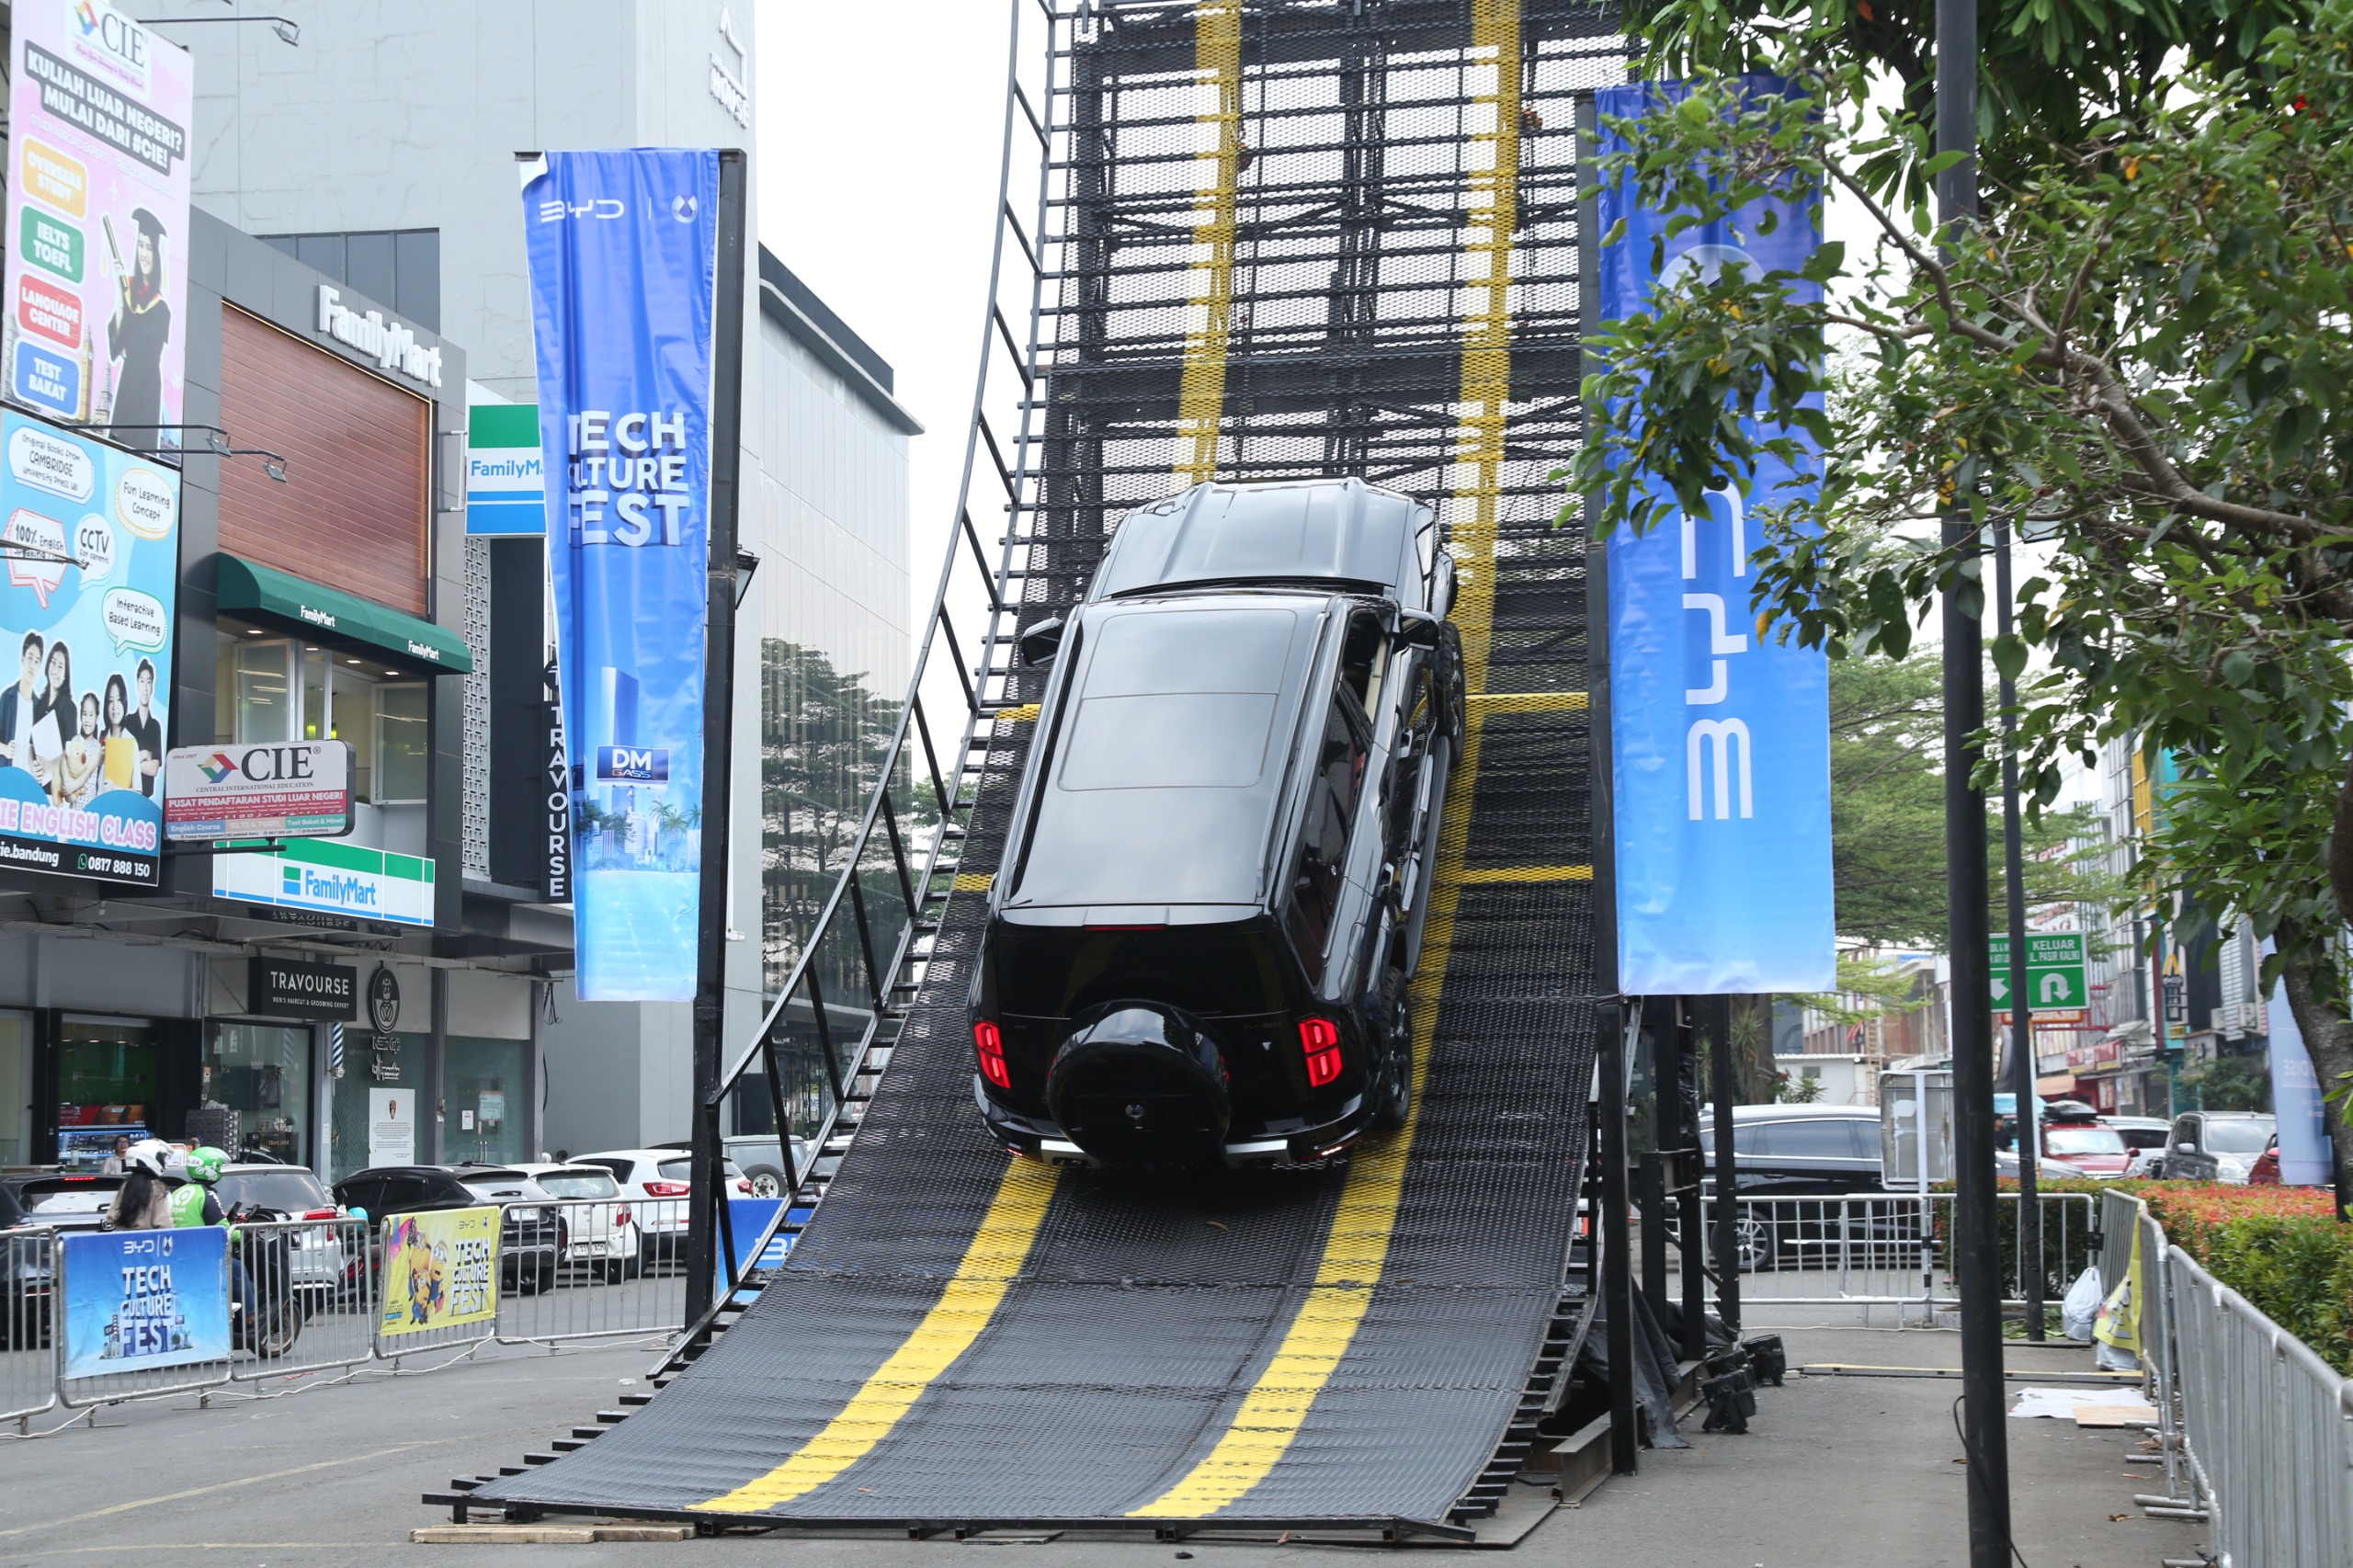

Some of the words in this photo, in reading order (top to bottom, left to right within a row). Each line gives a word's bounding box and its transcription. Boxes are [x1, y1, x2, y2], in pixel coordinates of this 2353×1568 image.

[101, 13, 144, 68] CIE
[28, 49, 86, 98] KULIAH
[86, 82, 124, 120] LUAR
[127, 105, 182, 151] NEGERI?
[44, 84, 93, 128] MULAI
[96, 112, 130, 148] DARI
[133, 132, 168, 169] #CIE!
[28, 151, 82, 191] OVERSEAS
[37, 173, 74, 201] STUDY
[540, 199, 625, 223] BYD
[37, 221, 71, 251] IELTS
[33, 238, 73, 273] TOEFL
[22, 286, 80, 324] LANGUAGE
[29, 307, 71, 336] CENTER
[319, 285, 442, 388] FamilyMart
[33, 357, 63, 381] TEST
[28, 373, 67, 402] BAKAT
[47, 442, 64, 456] Books
[29, 449, 74, 477] CAMBRIDGE
[123, 482, 137, 495] Fun
[139, 485, 170, 508] Learning
[131, 502, 161, 521] Concept
[16, 523, 38, 544] 100%
[40, 535, 64, 551] English
[80, 528, 109, 553] CCTV
[117, 598, 154, 618] Interactive
[301, 605, 335, 627] FamilyMart
[108, 612, 129, 627] Based
[131, 617, 161, 636] Learning
[408, 641, 439, 660] FamilyMart
[241, 746, 314, 782] CIE
[612, 749, 653, 771] DM
[278, 781, 314, 790] EDUCATION
[611, 769, 652, 778] GASS
[168, 799, 198, 808] PUSAT
[198, 795, 260, 807] PENDAFTARAN
[261, 793, 287, 803] STUDI
[288, 792, 311, 802] LUAR
[312, 791, 344, 801] NEGERI
[548, 706, 568, 897] TRAVOURSE
[21, 803, 98, 842] ENGLISH
[101, 814, 156, 850] CLASS
[171, 824, 196, 833] English
[0, 841, 59, 867] ie.bandung
[88, 856, 111, 873] 0817
[113, 859, 131, 875] 888
[134, 862, 150, 878] 150
[306, 869, 376, 905] FamilyMart
[2032, 939, 2075, 950] KELUAR
[2040, 951, 2058, 961] PASIR
[271, 971, 349, 994] TRAVOURSE
[459, 1221, 476, 1230] BYD
[123, 1240, 154, 1255] BYD
[456, 1237, 491, 1267] TECH
[122, 1265, 172, 1298] TECH
[453, 1262, 488, 1284] CULTURE
[120, 1294, 172, 1318] CULTURE
[449, 1284, 489, 1317] FEST
[119, 1318, 176, 1358] FEST
